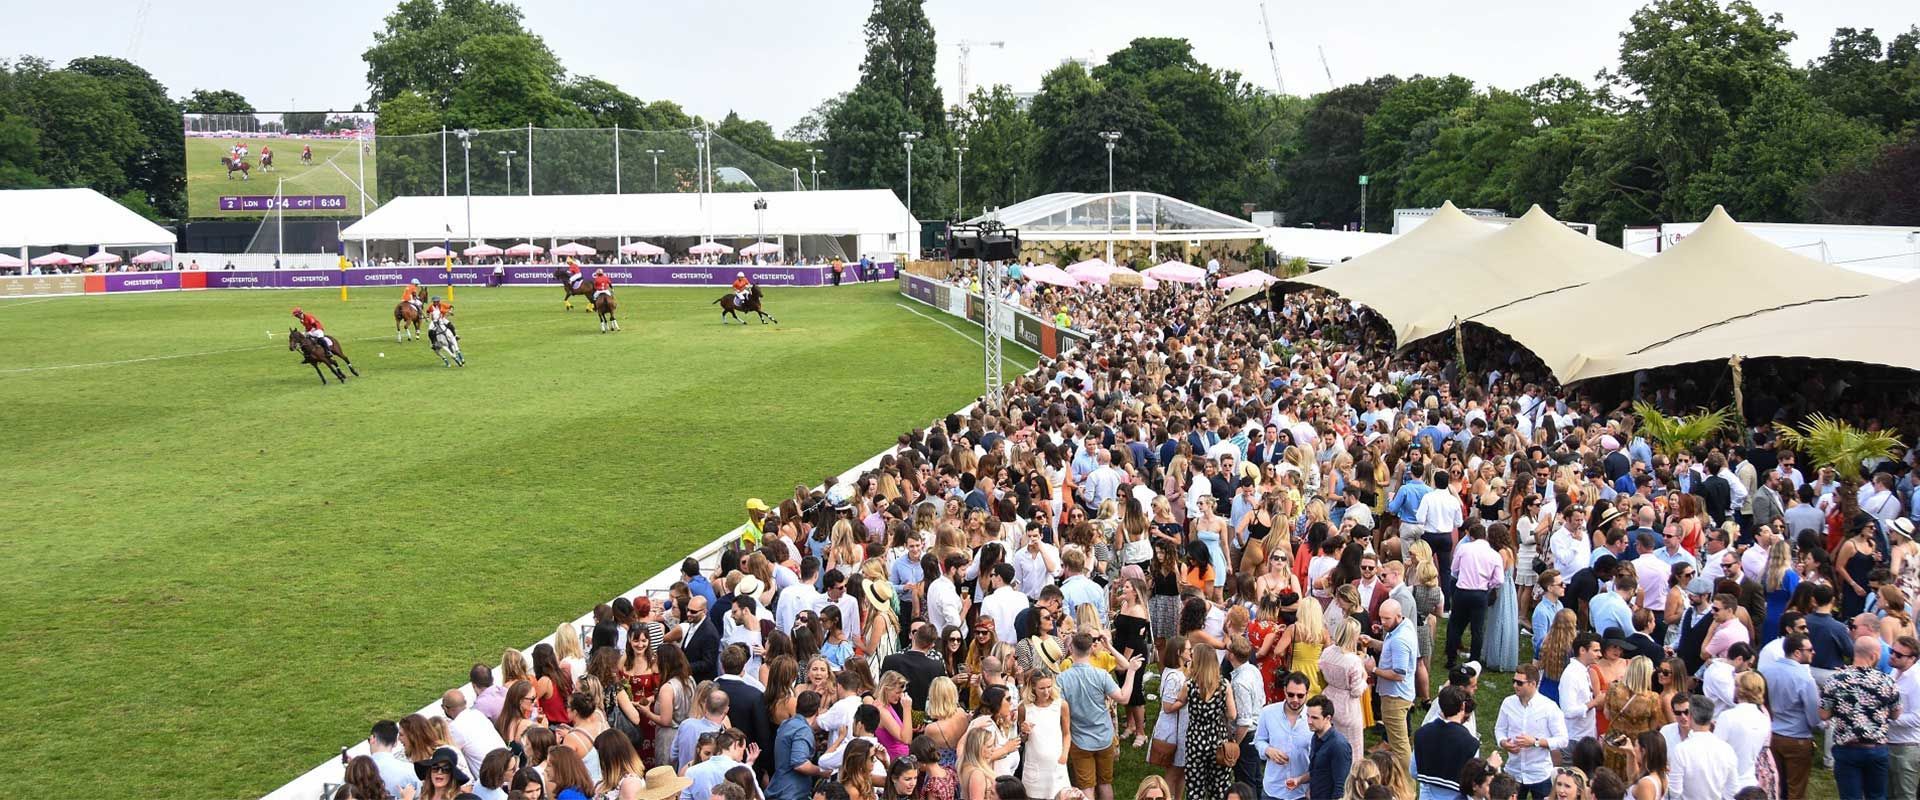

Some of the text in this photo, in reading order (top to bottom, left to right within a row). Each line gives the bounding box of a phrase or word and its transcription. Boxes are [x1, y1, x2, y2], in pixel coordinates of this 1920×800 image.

[321, 199, 341, 207] 6:04
[671, 272, 713, 280] CHESTERTONS
[752, 273, 795, 281] CHESTERTONS
[124, 278, 163, 286] CHESTERTONS
